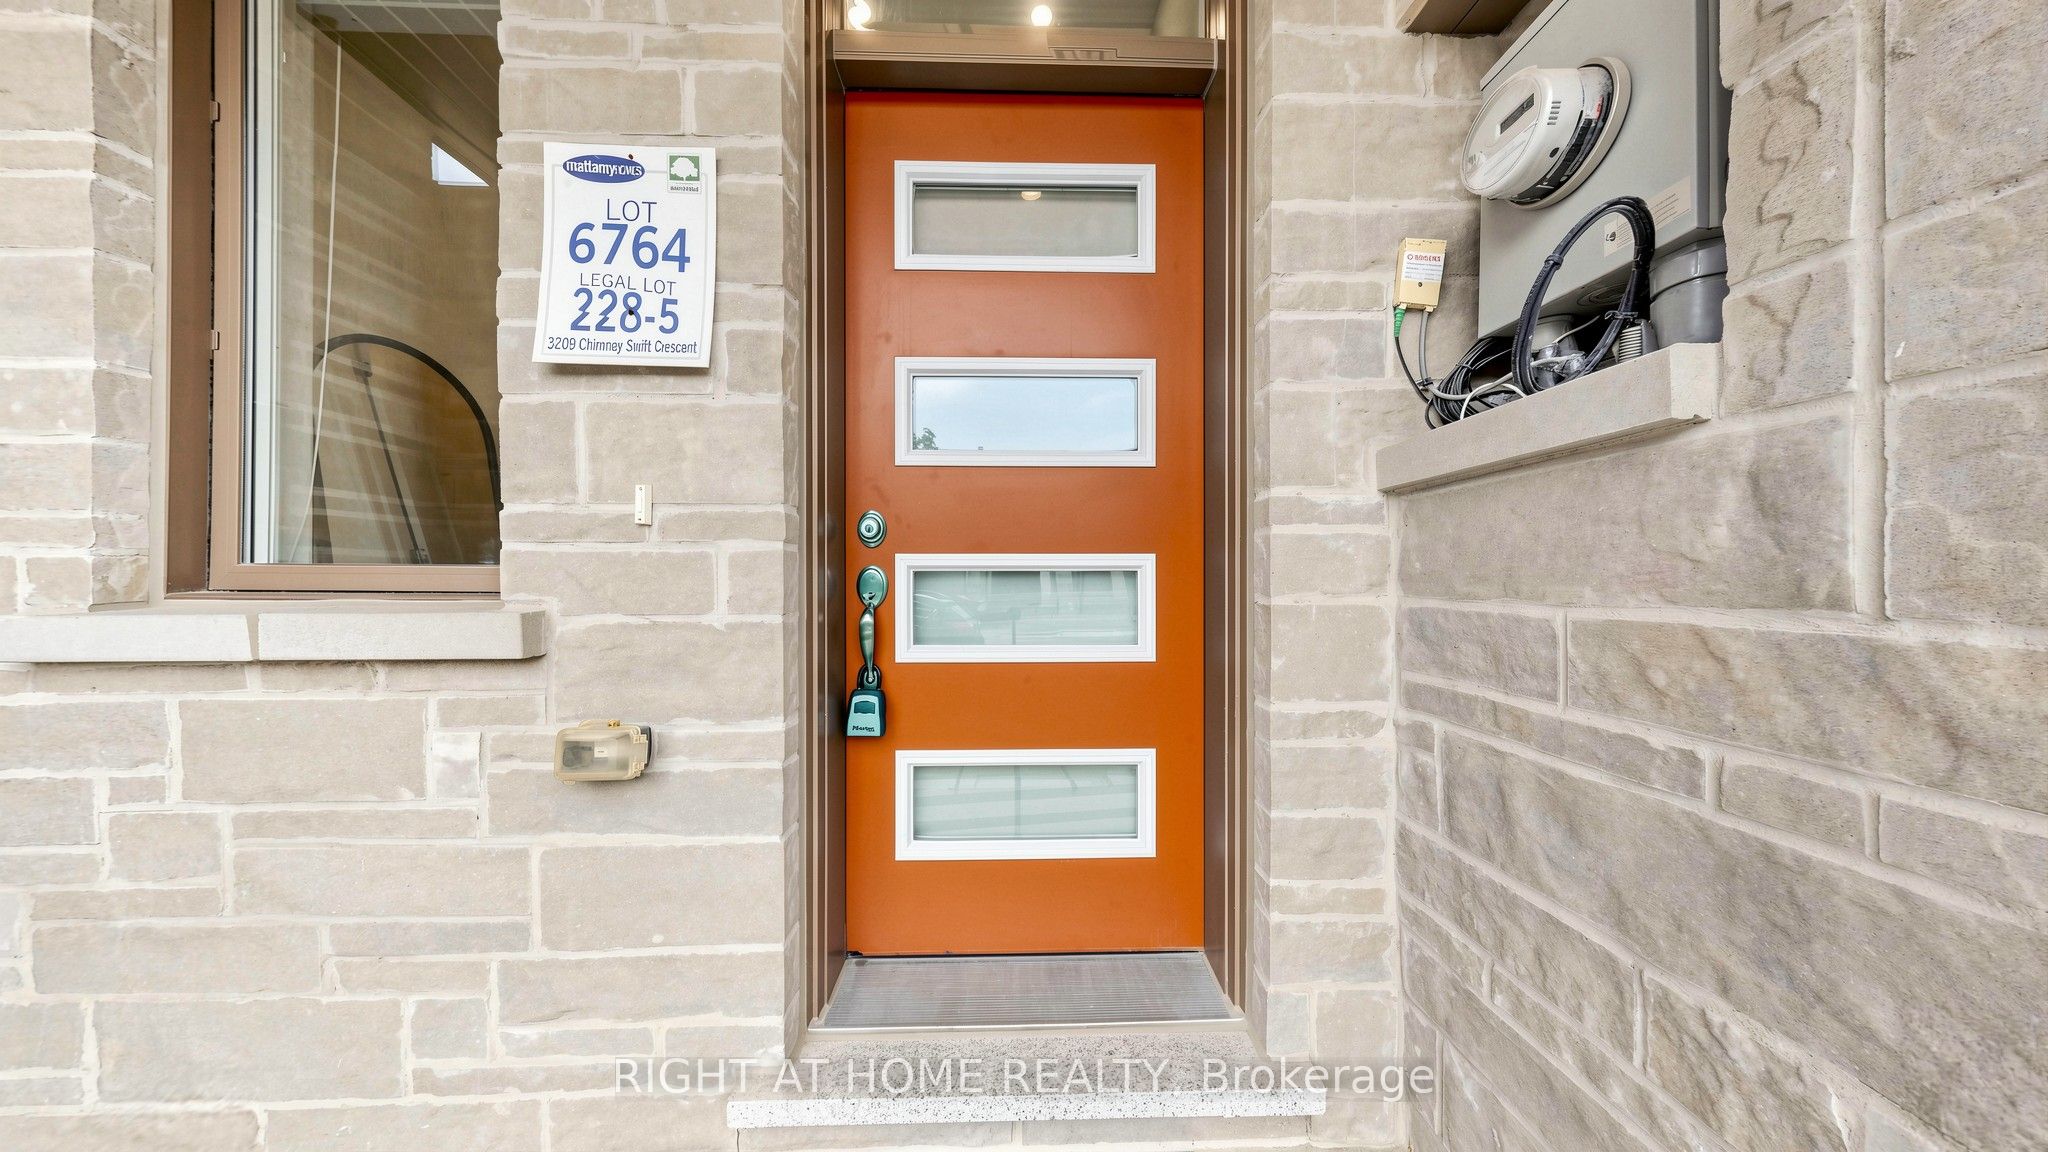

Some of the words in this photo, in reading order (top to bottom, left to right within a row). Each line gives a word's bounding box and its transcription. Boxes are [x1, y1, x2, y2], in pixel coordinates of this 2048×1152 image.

[606, 199, 657, 223] LOT
[568, 222, 690, 273] 6764
[580, 273, 636, 291] LEGAL
[643, 278, 677, 296] LOT
[570, 288, 679, 334] 228-5
[547, 336, 576, 351] 3209
[579, 337, 623, 354] Chimney
[626, 339, 651, 353] Swift
[654, 340, 697, 354] Crescent
